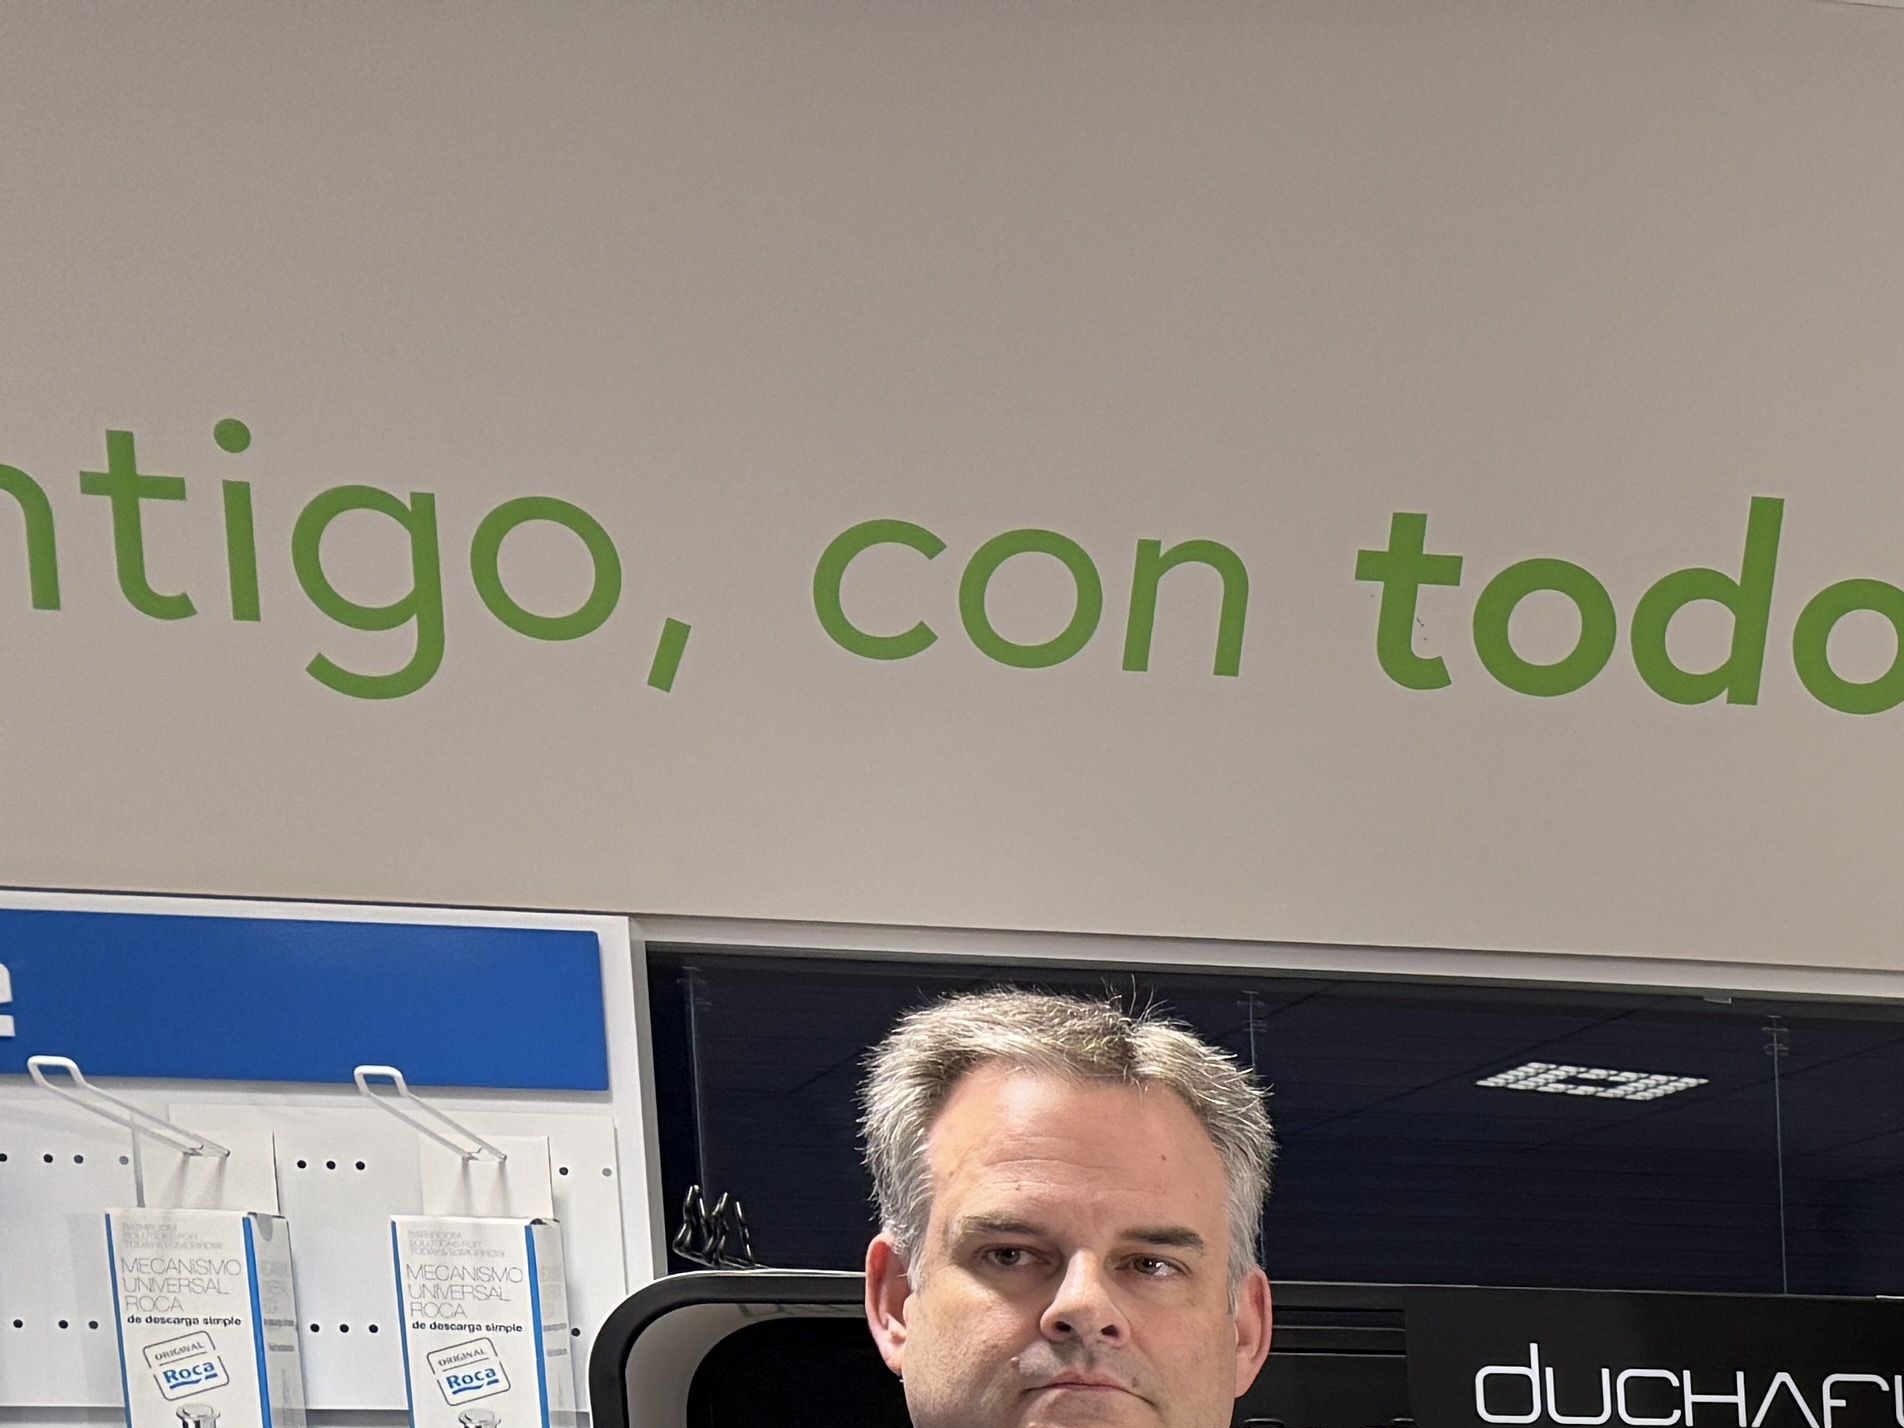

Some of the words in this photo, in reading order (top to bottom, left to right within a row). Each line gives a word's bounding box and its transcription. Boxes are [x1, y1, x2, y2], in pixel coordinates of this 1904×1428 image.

[813, 517, 1251, 678] con
[121, 1257, 242, 1276] MECANISMO
[407, 1264, 523, 1283] MECANISMO
[122, 1277, 229, 1295] UNIVERSAL
[408, 1285, 511, 1302] UNIVERSAL
[125, 1295, 184, 1313] ROCA
[410, 1302, 467, 1319] ROCA
[127, 1315, 142, 1324] de
[145, 1316, 200, 1326] descarga
[202, 1316, 242, 1327] simple
[412, 1321, 426, 1330] de
[430, 1322, 482, 1333] descarga
[485, 1323, 523, 1333] simple
[155, 1341, 204, 1361] ORIGINAL
[438, 1348, 487, 1367] ORIGINAL
[163, 1361, 216, 1384] Roca
[446, 1367, 497, 1389] Roca
